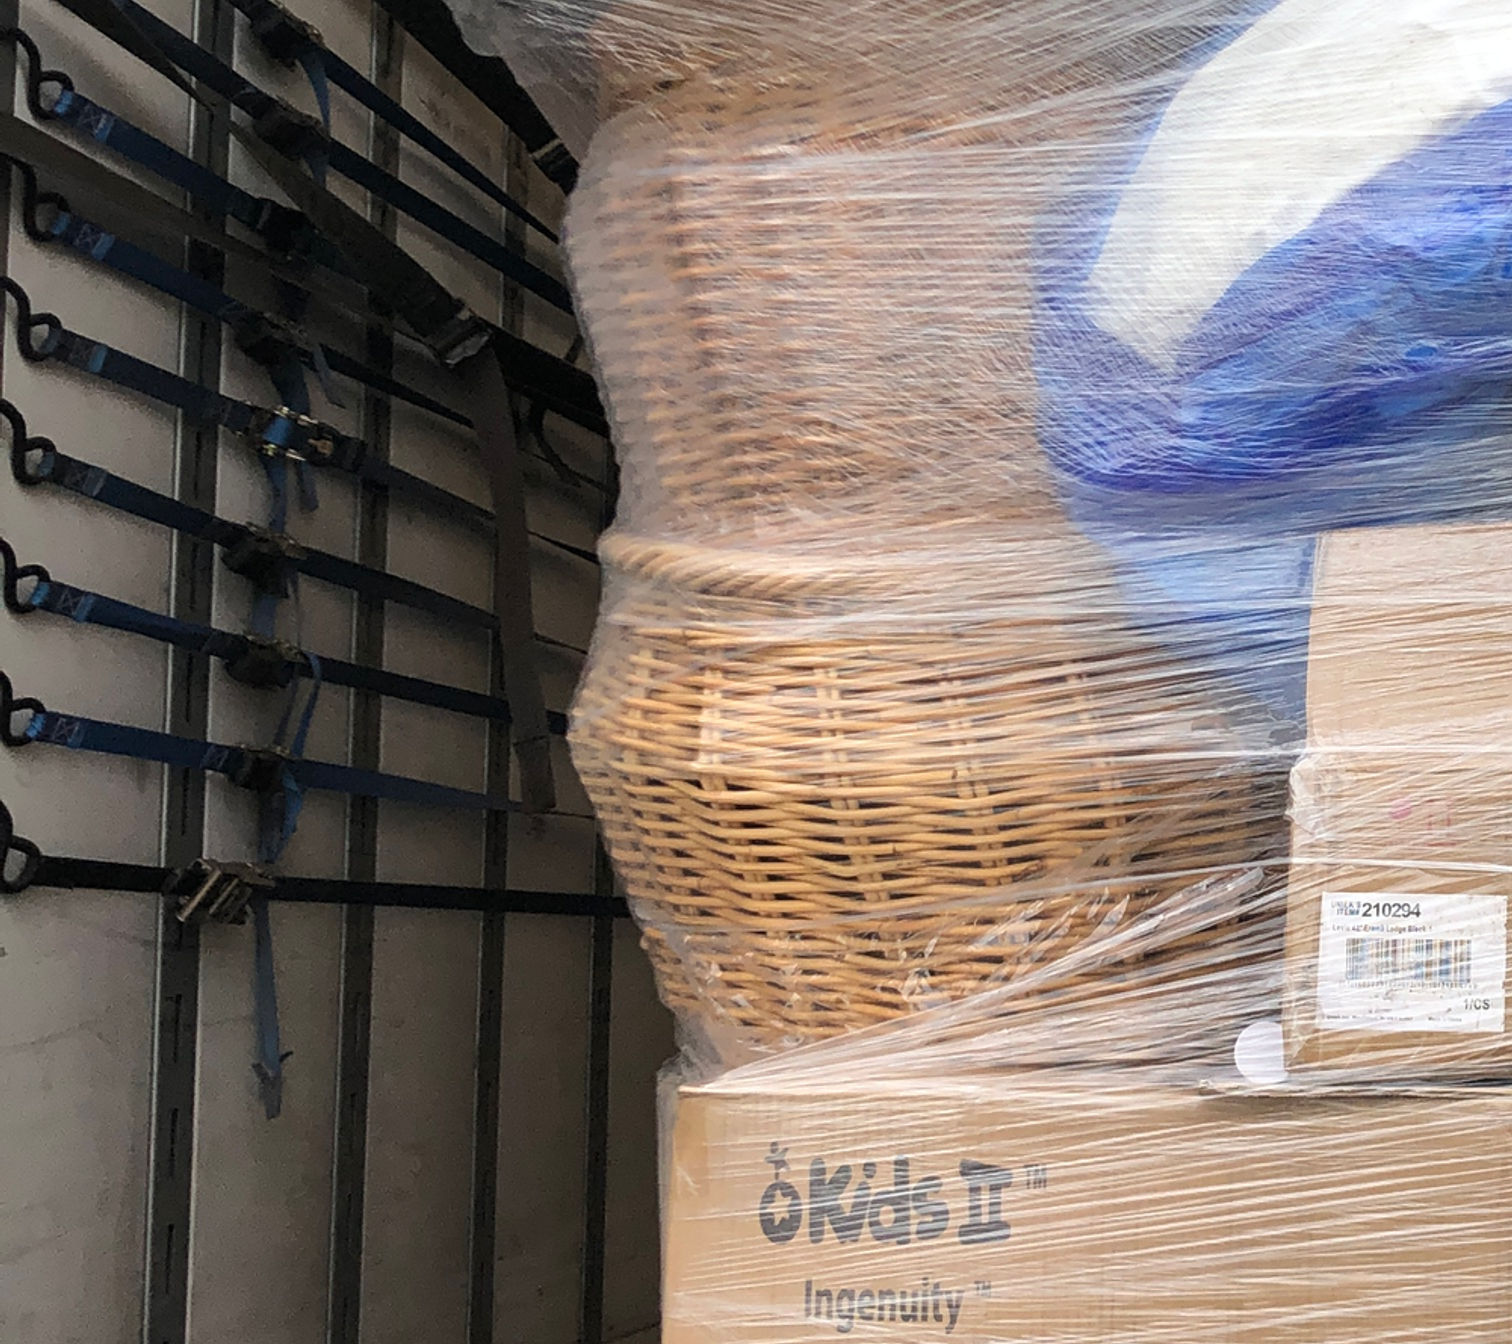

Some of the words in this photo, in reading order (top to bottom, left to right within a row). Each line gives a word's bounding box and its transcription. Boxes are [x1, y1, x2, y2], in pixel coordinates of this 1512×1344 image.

[1361, 902, 1421, 918] 210294
[1463, 998, 1491, 1011] 1/CS
[808, 1155, 950, 1245] Kids
[958, 1158, 1013, 1245] II
[804, 1277, 965, 1335] Ingenuity
